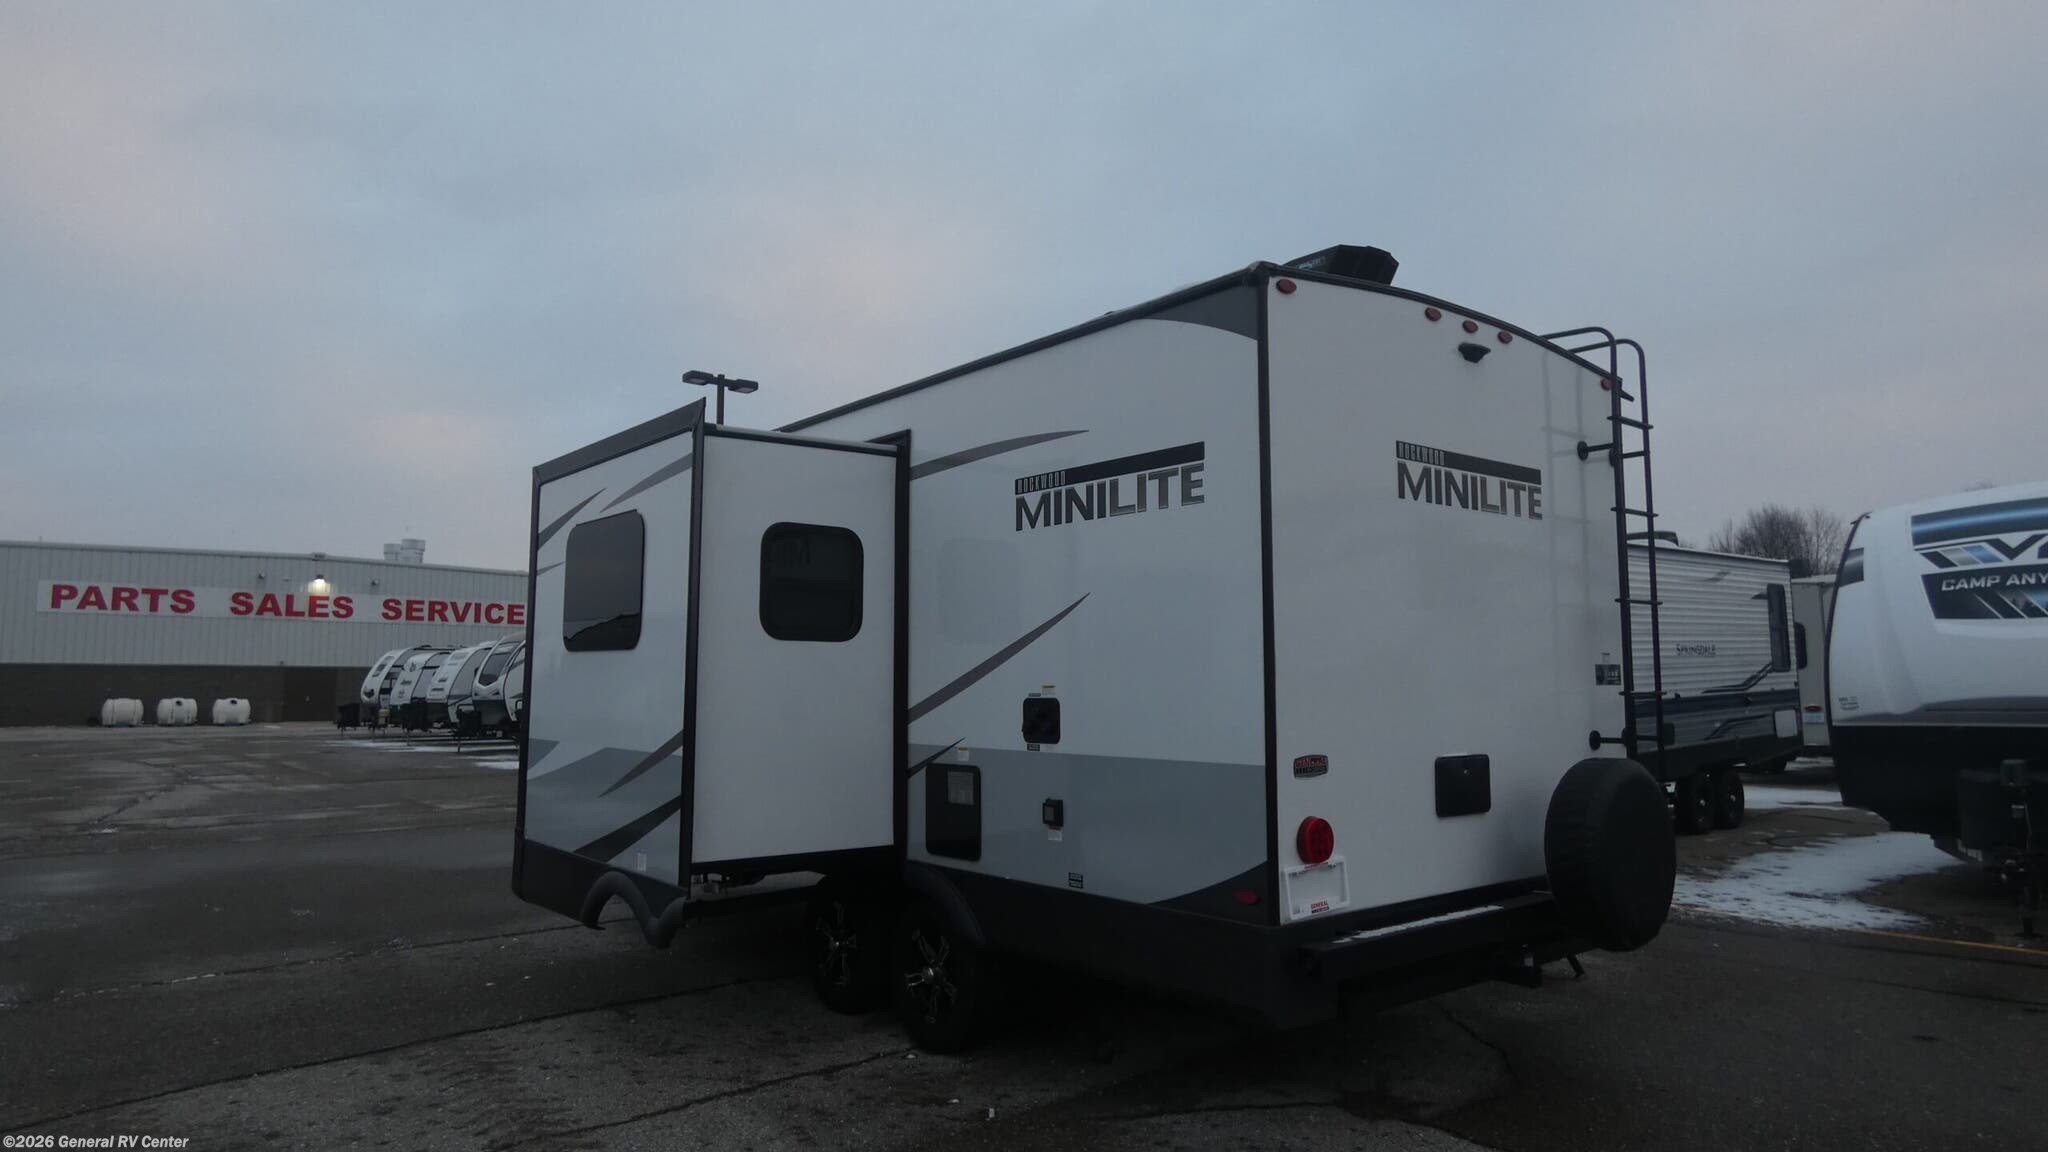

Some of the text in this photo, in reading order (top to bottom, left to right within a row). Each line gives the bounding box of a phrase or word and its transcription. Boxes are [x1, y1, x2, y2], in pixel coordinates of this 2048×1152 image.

[1015, 462, 1205, 531] MINILITE
[1397, 461, 1542, 520] MINILITE
[51, 584, 525, 625] PARTS SALES SERVICE
[1941, 574, 2001, 592] CAMP
